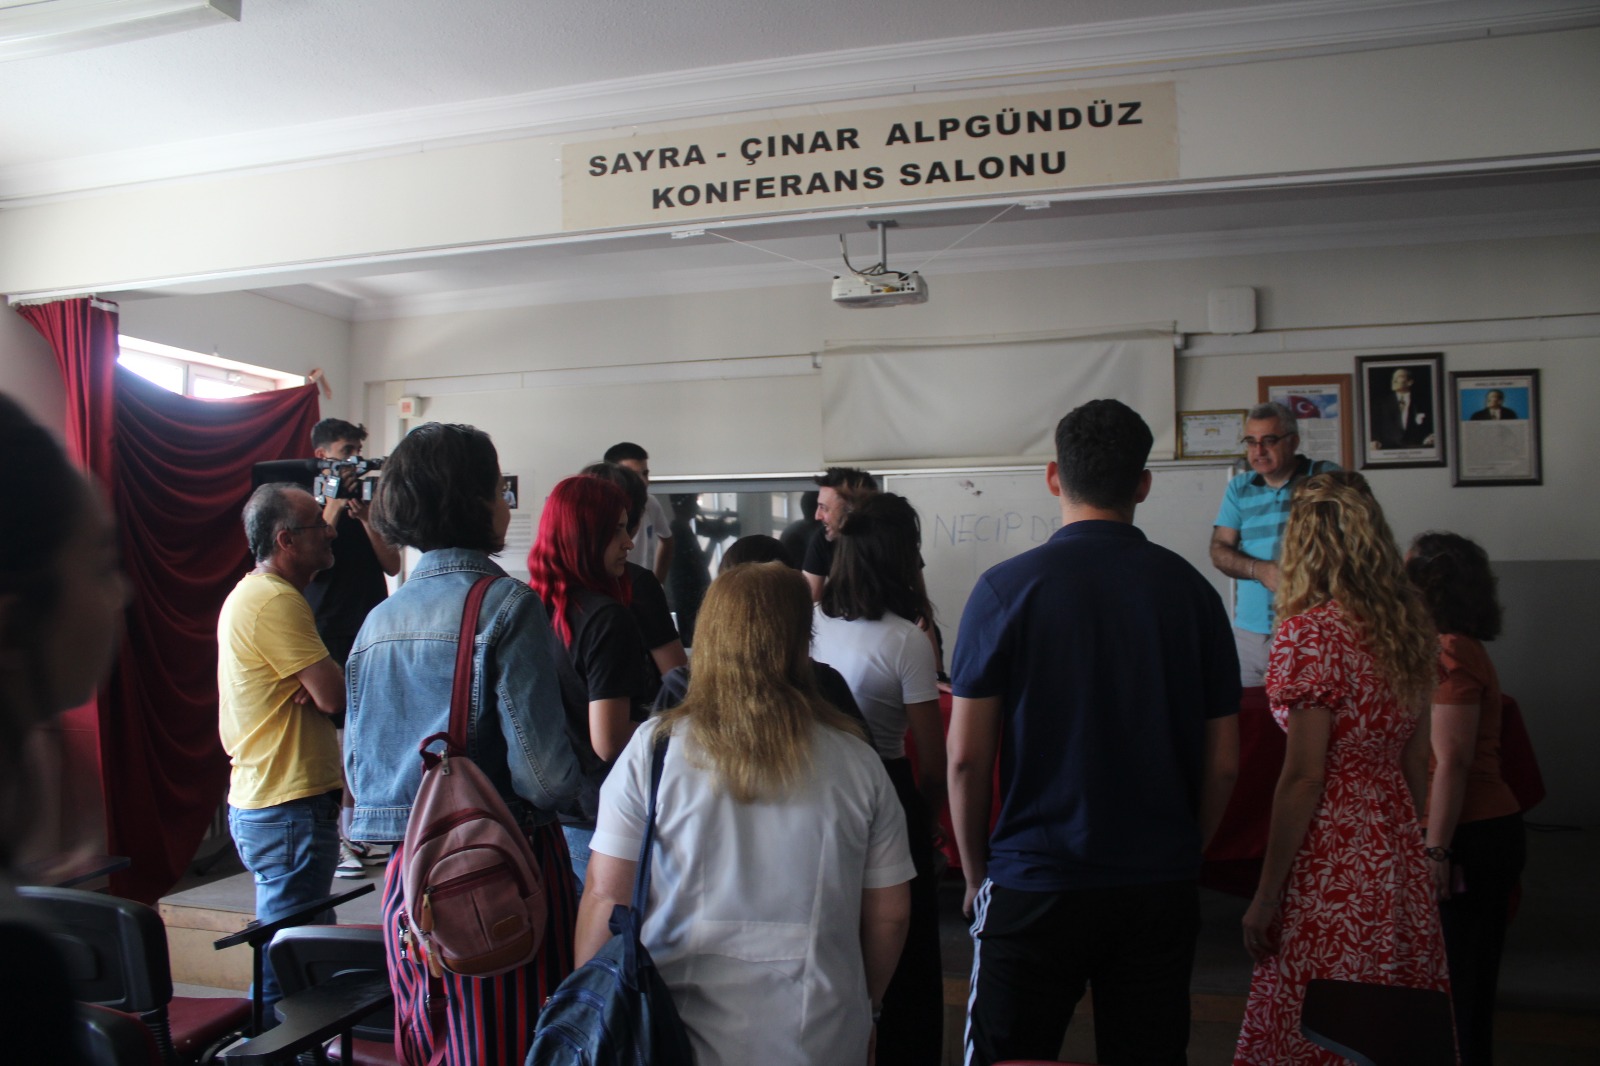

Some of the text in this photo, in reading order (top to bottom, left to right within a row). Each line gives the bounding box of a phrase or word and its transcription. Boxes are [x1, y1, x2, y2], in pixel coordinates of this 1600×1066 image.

[589, 144, 706, 177] SAYRA
[740, 128, 860, 165] ÇINAR
[885, 100, 1143, 146] ALPGÜNDÜZ
[653, 150, 1066, 209] KONFERANS SALONU
